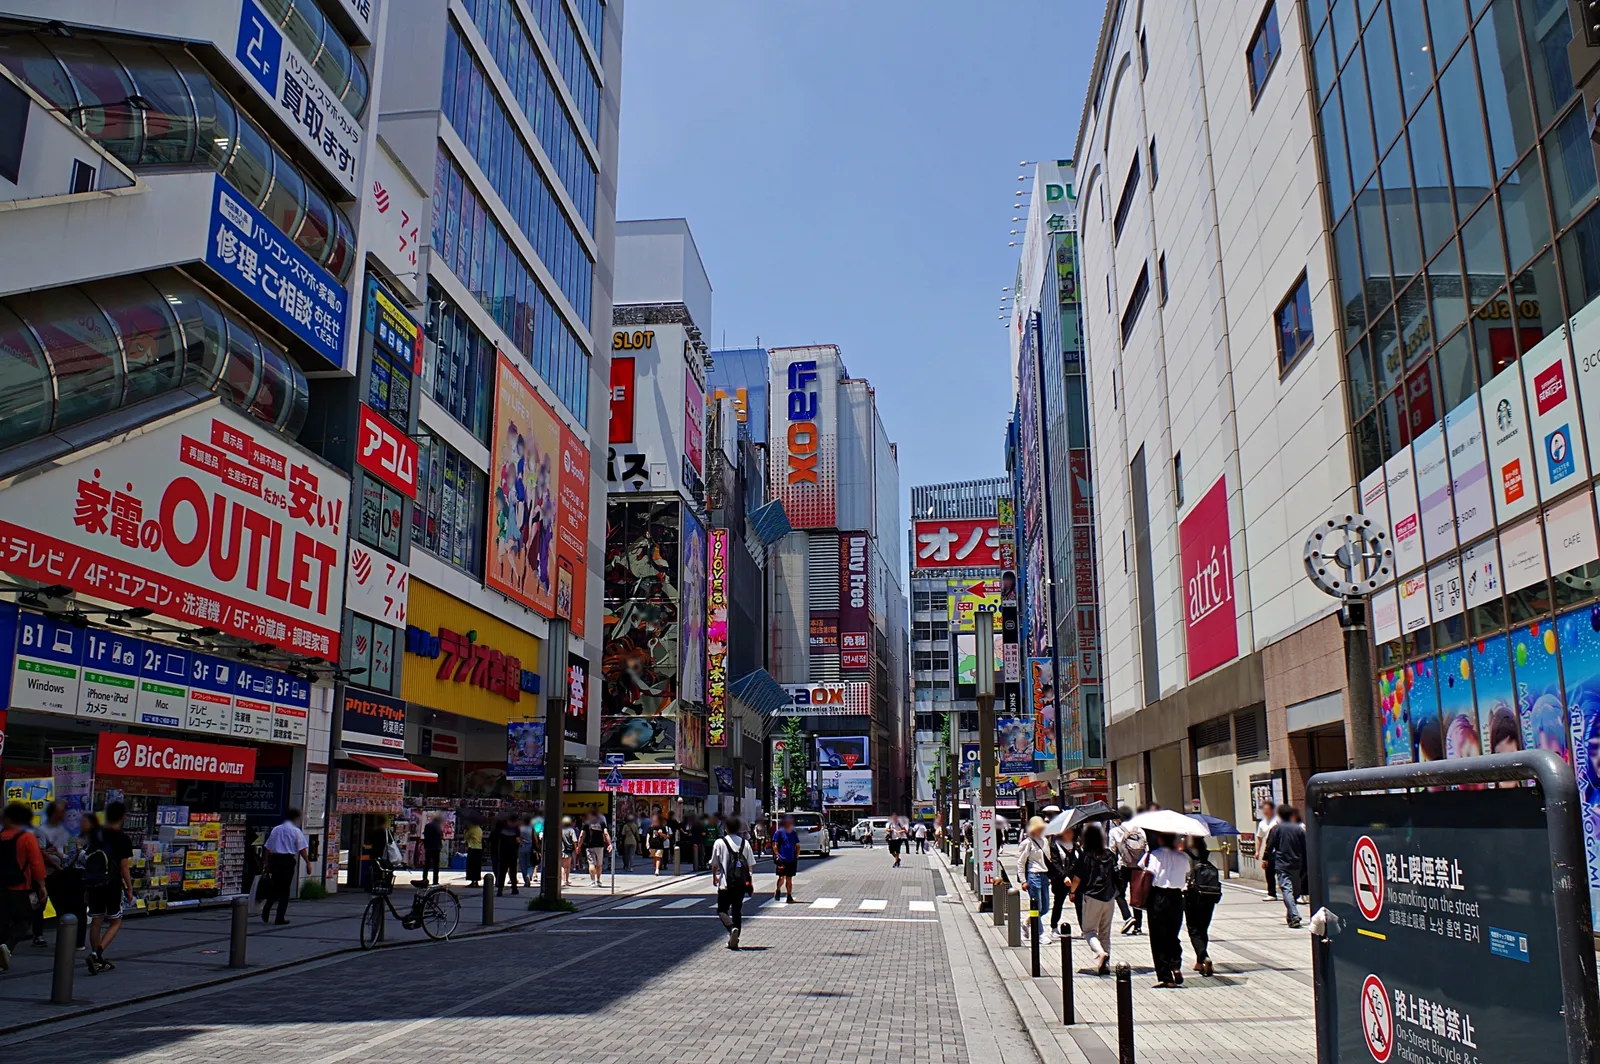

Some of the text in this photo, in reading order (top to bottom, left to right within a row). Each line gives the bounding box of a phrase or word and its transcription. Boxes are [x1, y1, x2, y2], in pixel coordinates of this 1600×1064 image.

[246, 16, 270, 75] 2F
[286, 51, 359, 143] パソコン・スマホ・カメラ
[216, 224, 313, 330] 修理・ご相談
[253, 224, 341, 313] パソコン・スマホ・家電の
[315, 305, 340, 336] お任せ
[315, 326, 338, 350] ください
[613, 331, 655, 349] SLOT
[222, 431, 244, 451] 展示品
[1496, 428, 1519, 446] STARBUCKS
[189, 445, 219, 470] 再調整品
[364, 418, 413, 485] アコム
[227, 466, 259, 491] 生産完了品
[570, 460, 586, 487] Spotify
[1552, 461, 1570, 475] MISTER
[263, 486, 288, 510] だから
[287, 464, 343, 536] 安い!
[73, 469, 336, 617] 家電の OUTLET
[849, 537, 866, 608] Duty Free
[1189, 545, 1232, 621] atré 1
[22, 624, 44, 648] B1
[89, 636, 106, 660] 1F
[844, 635, 865, 646] 免税
[144, 650, 162, 671] 2F
[193, 660, 209, 681] 3F
[844, 655, 866, 663] 면세점
[1083, 653, 1092, 676] EV
[28, 678, 65, 694] Windows
[237, 670, 252, 689] 4F
[276, 679, 289, 697] 5F
[86, 701, 107, 714] カメラ
[155, 699, 169, 710] Mac
[190, 704, 207, 716] テレビ
[345, 697, 405, 721] アクセスチケット
[189, 716, 217, 728] レコーダー
[233, 723, 254, 734] エアコン
[234, 711, 251, 723] 洗濯機
[274, 718, 289, 728] 冷蔵庫
[383, 720, 404, 735] 秋葉原店
[135, 745, 244, 775] BicCamera OUTLET
[8, 788, 22, 799] 中古
[628, 781, 676, 794] 秋葉原駅前店
[1571, 705, 1600, 890] SHIZUKA MOGAMI
[982, 823, 995, 886] ライブ禁止
[1386, 853, 1464, 890] 路上喫煙禁止
[1388, 887, 1480, 918] No smoking on the street
[1430, 917, 1444, 935] 노상
[1446, 919, 1461, 939] 흡연
[1464, 922, 1480, 943] 금지
[1394, 989, 1477, 1049] 路上駐輪禁止
[1396, 1024, 1470, 1063] On-Street Bicycle &
